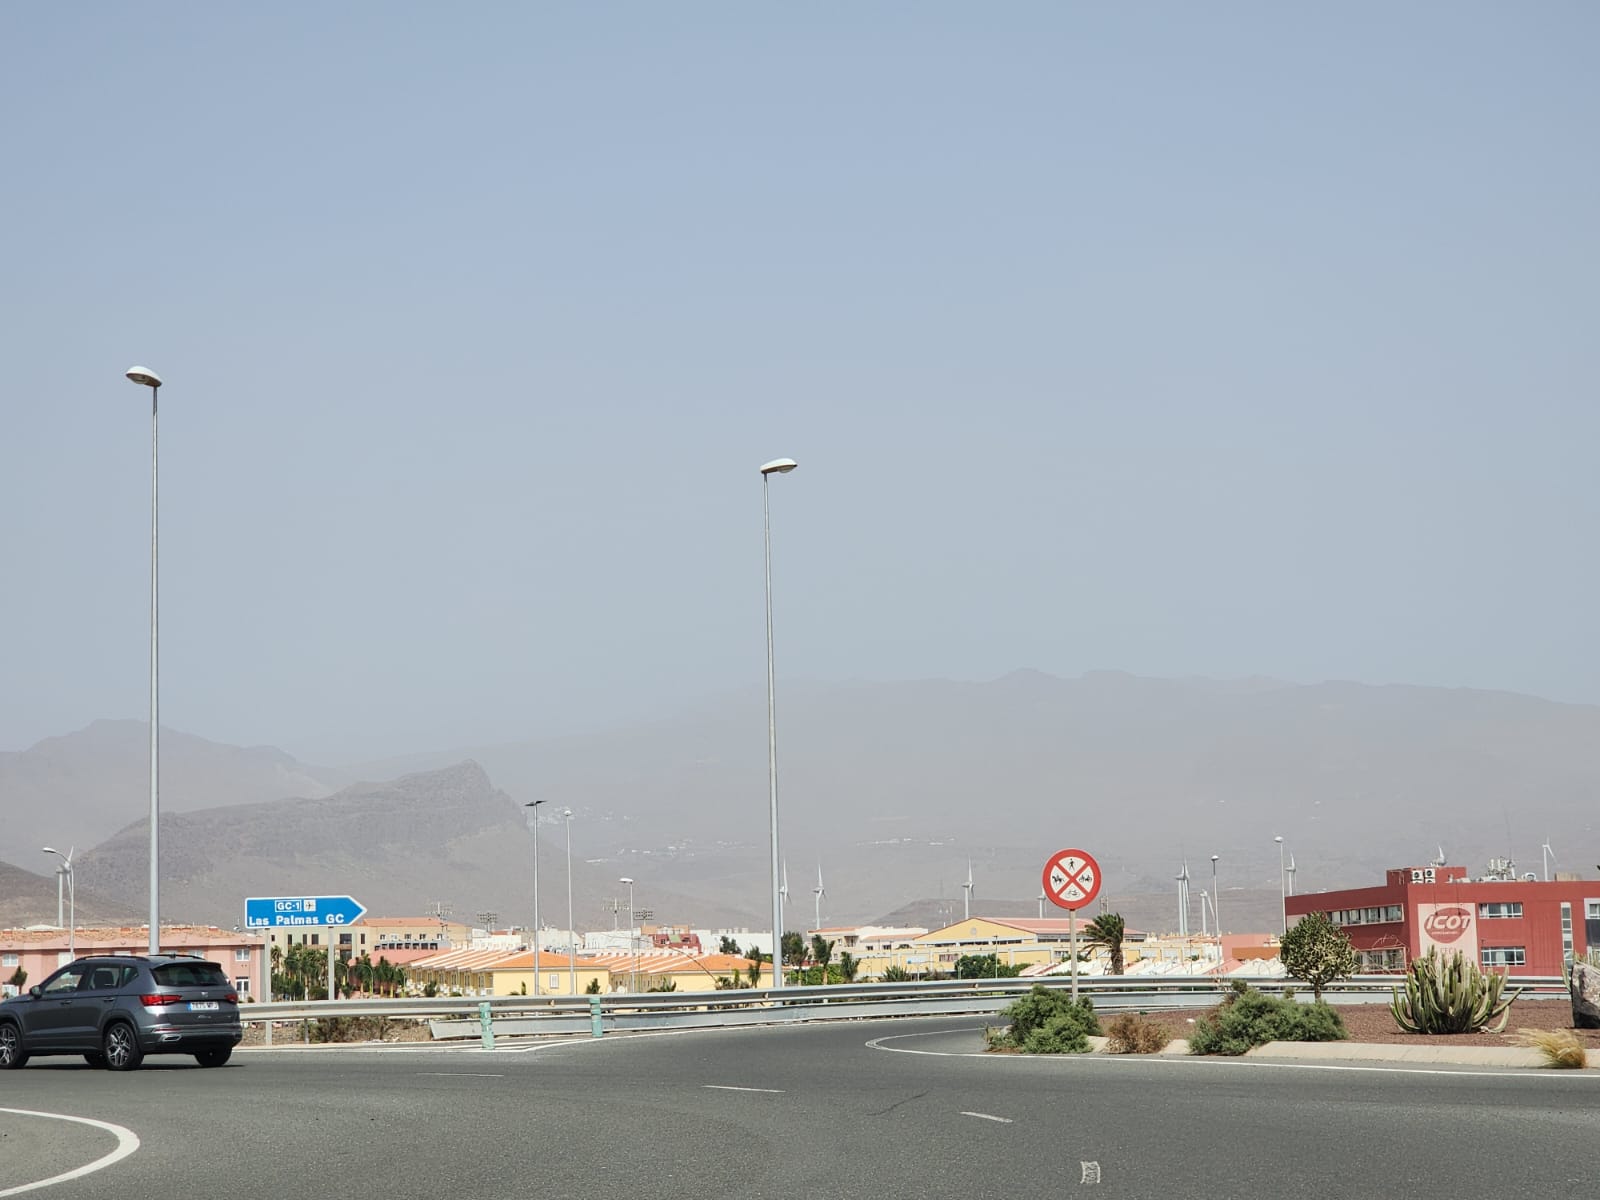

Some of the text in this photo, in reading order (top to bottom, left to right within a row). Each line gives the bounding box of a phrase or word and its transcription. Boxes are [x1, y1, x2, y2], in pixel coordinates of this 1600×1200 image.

[277, 902, 300, 910] GC-1
[249, 914, 345, 926] Las Palmas GC
[1426, 915, 1471, 930] ICOT
